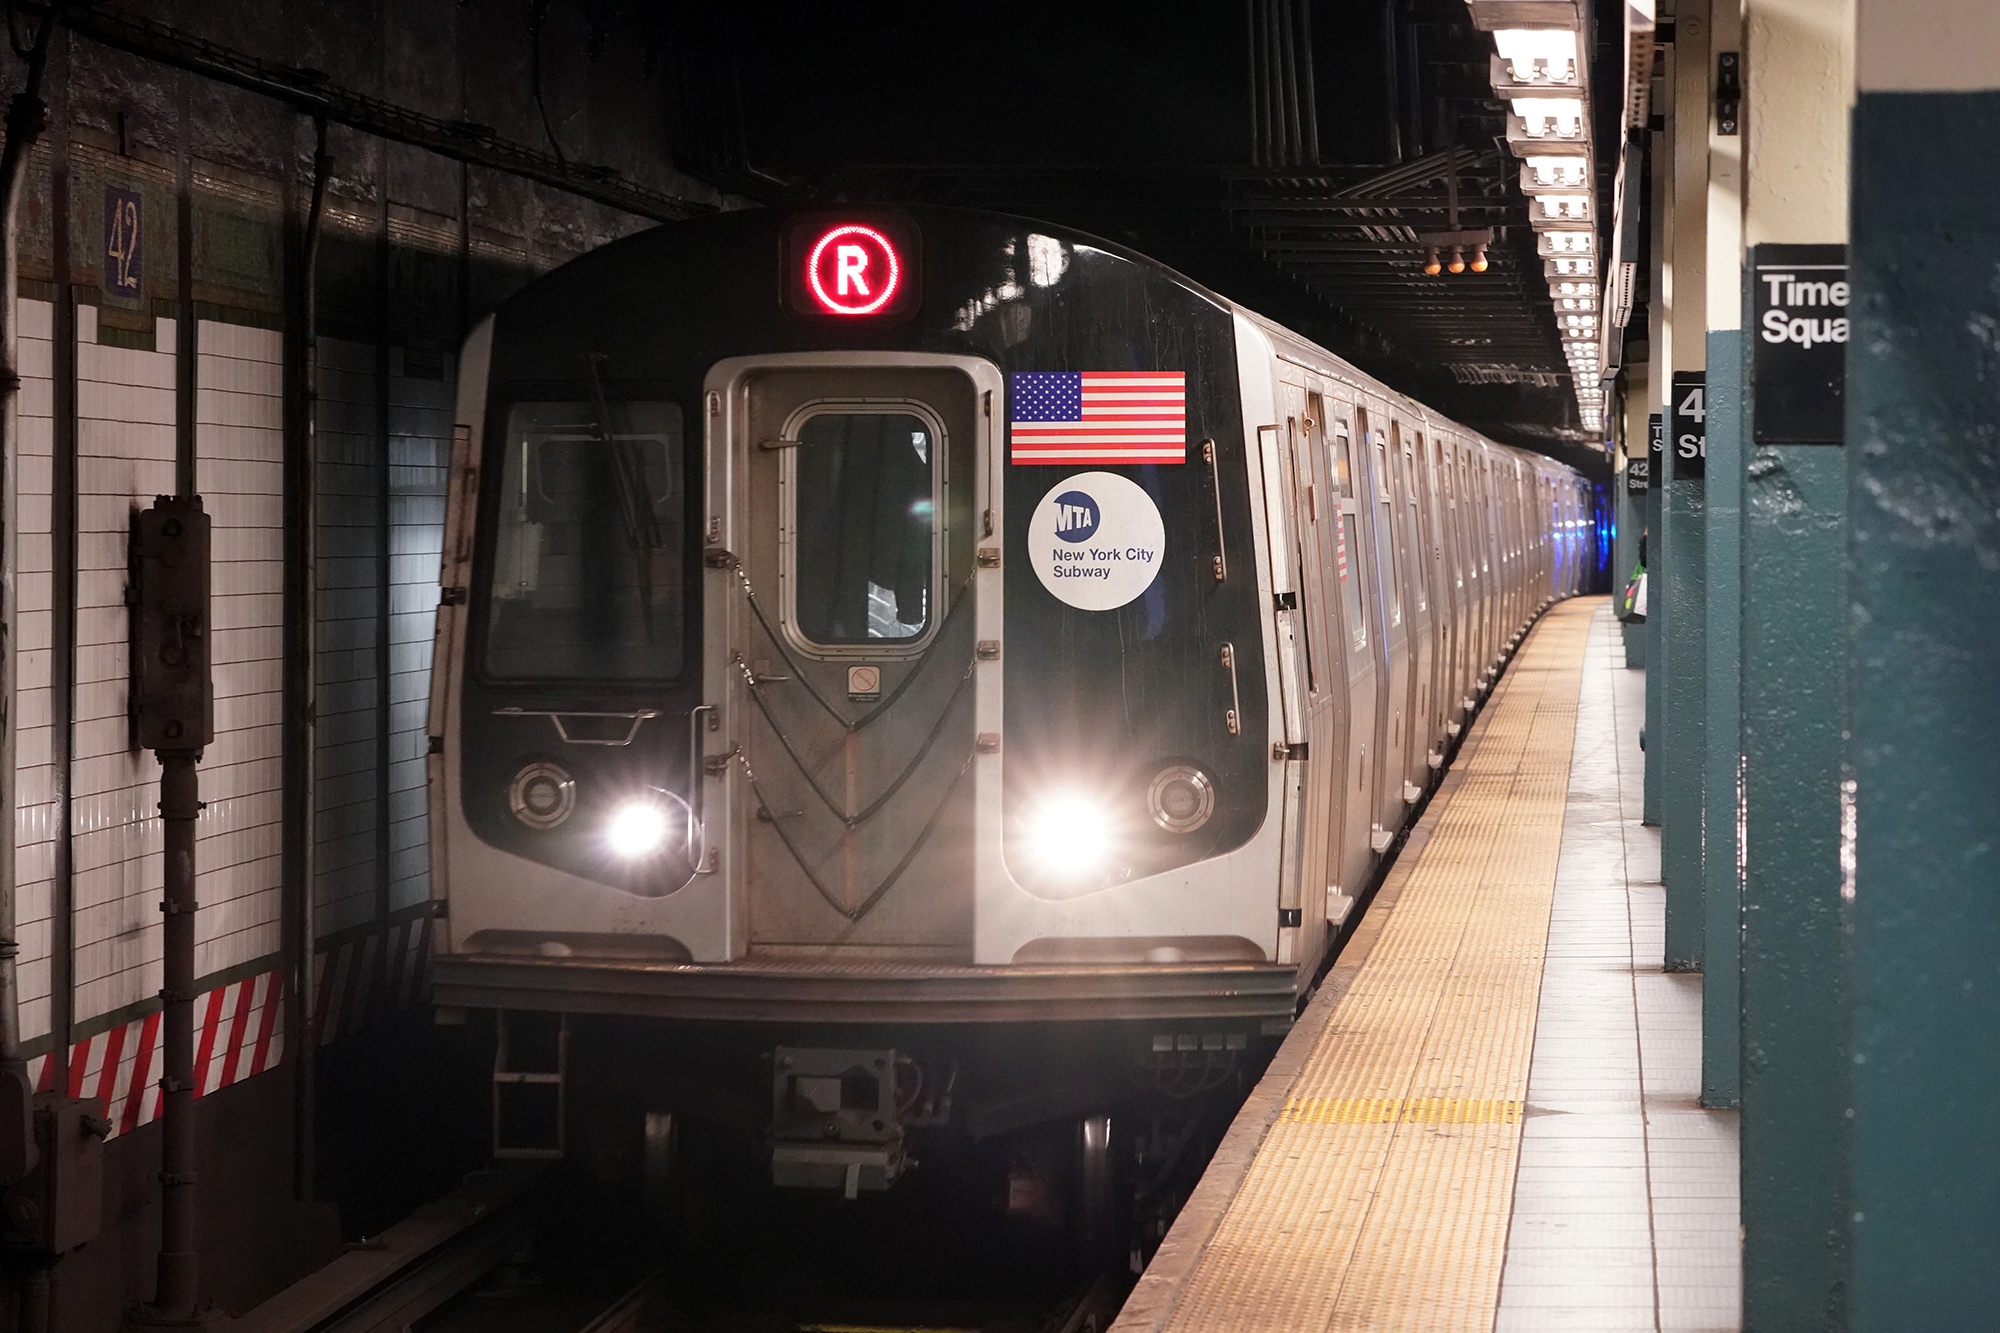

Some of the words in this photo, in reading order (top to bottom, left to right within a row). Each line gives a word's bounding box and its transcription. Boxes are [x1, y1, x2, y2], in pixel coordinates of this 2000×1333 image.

[108, 198, 138, 289] 42
[837, 245, 870, 295] R
[1761, 274, 1849, 306] Time
[1628, 463, 1648, 476] 42
[1053, 502, 1093, 533] MTA
[1052, 549, 1085, 561] New
[1089, 548, 1121, 561] York
[1125, 548, 1154, 563] City
[1053, 565, 1111, 579] Subway
